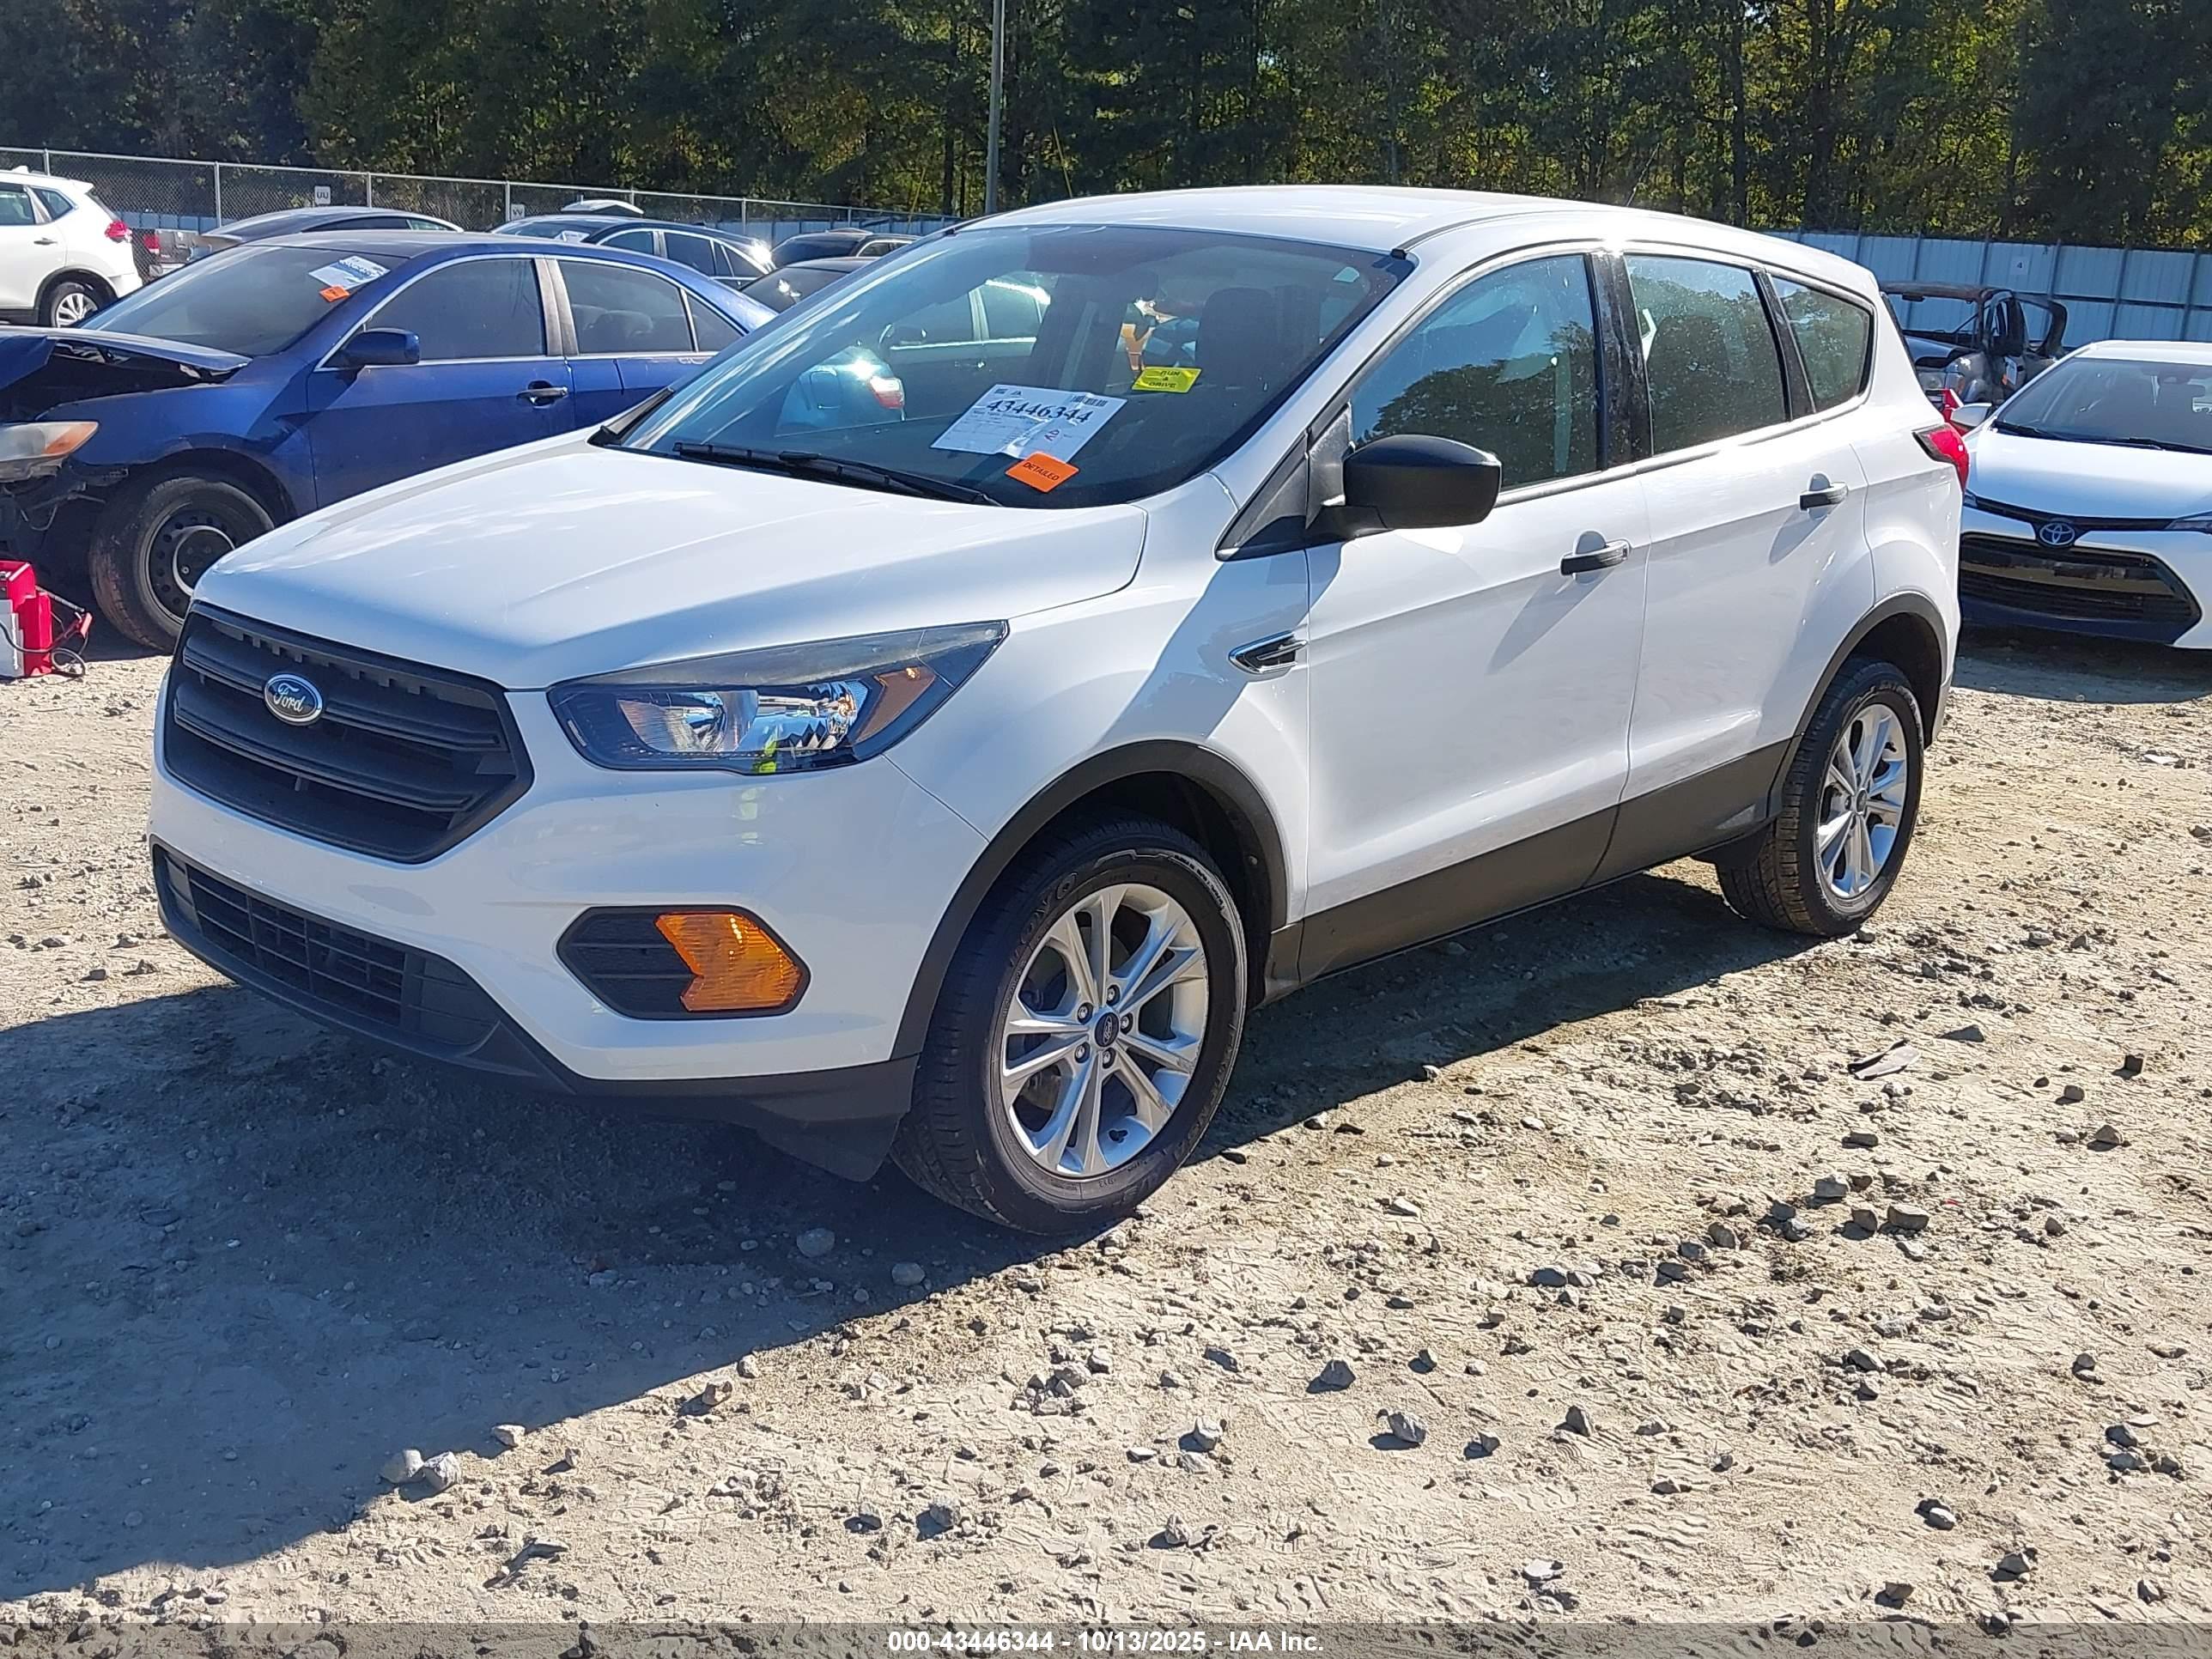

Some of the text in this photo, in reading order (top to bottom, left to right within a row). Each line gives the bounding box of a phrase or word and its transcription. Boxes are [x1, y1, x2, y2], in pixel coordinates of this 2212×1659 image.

[987, 399, 1094, 423] 43446344
[1023, 462, 1060, 481] DETAILED
[273, 683, 307, 713] Ford
